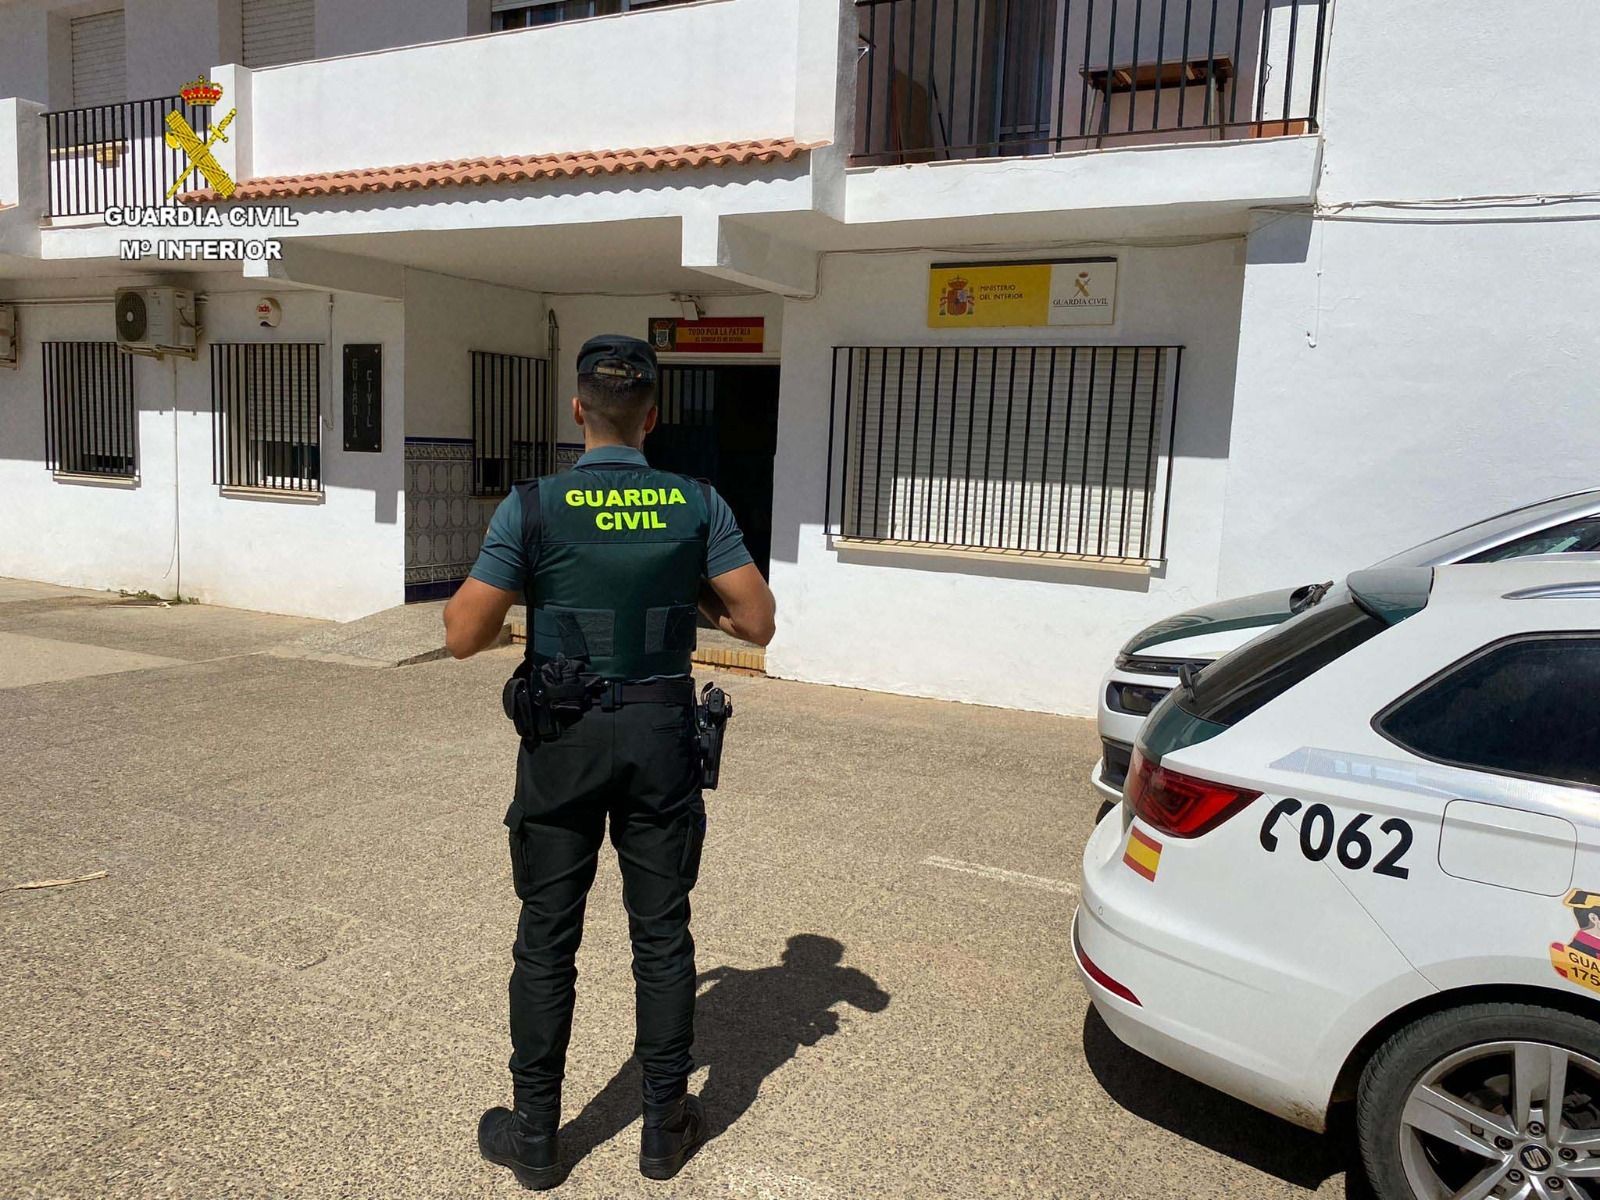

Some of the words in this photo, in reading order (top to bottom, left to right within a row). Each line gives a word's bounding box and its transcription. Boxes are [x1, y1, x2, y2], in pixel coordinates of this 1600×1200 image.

[565, 488, 687, 507] GUARDIA
[595, 511, 667, 530] CIVIL
[1300, 803, 1414, 880] 062
